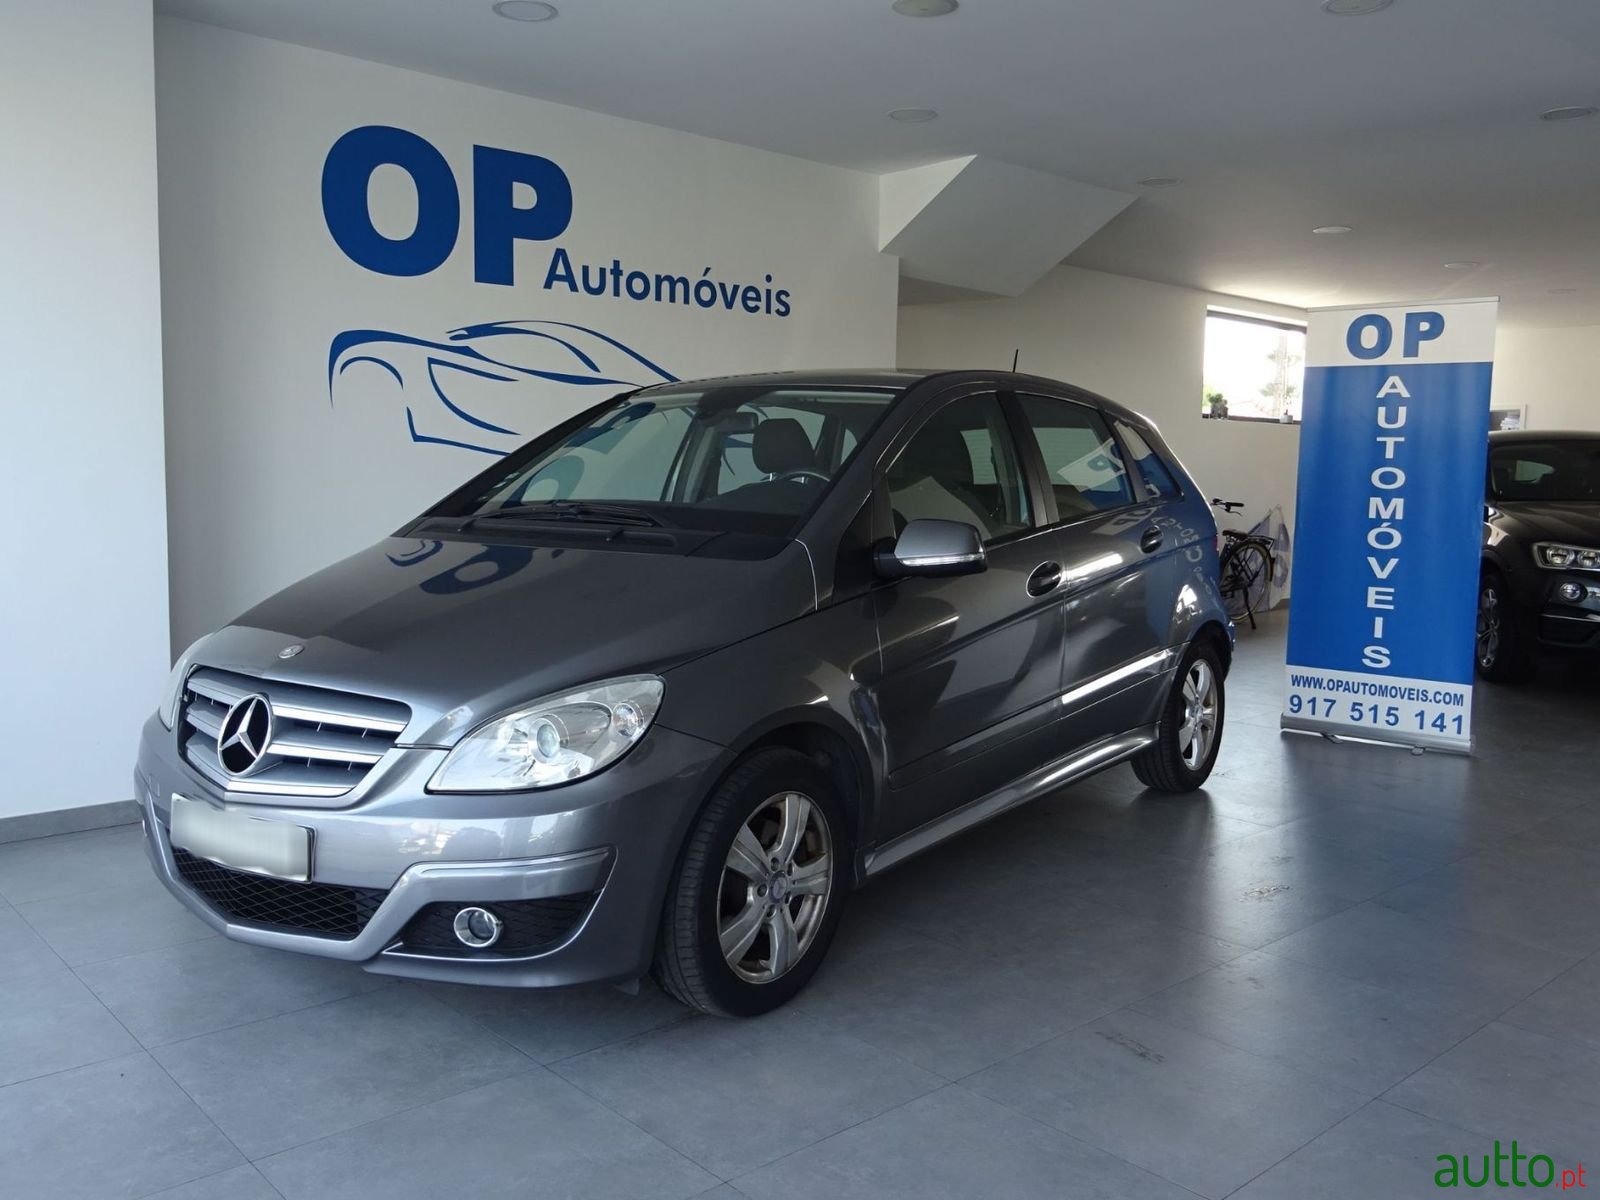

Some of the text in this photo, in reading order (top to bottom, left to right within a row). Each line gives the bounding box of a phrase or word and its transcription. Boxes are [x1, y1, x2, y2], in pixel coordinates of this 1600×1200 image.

[321, 125, 573, 286] OP
[543, 247, 791, 317] Automóveis
[1346, 311, 1445, 360] OP
[1361, 375, 1411, 668] AUTOMÓVEIS
[1289, 694, 1464, 735] 917 515 141
[1290, 674, 1464, 707] WWW.OPAUTOMOVEIS.COM
